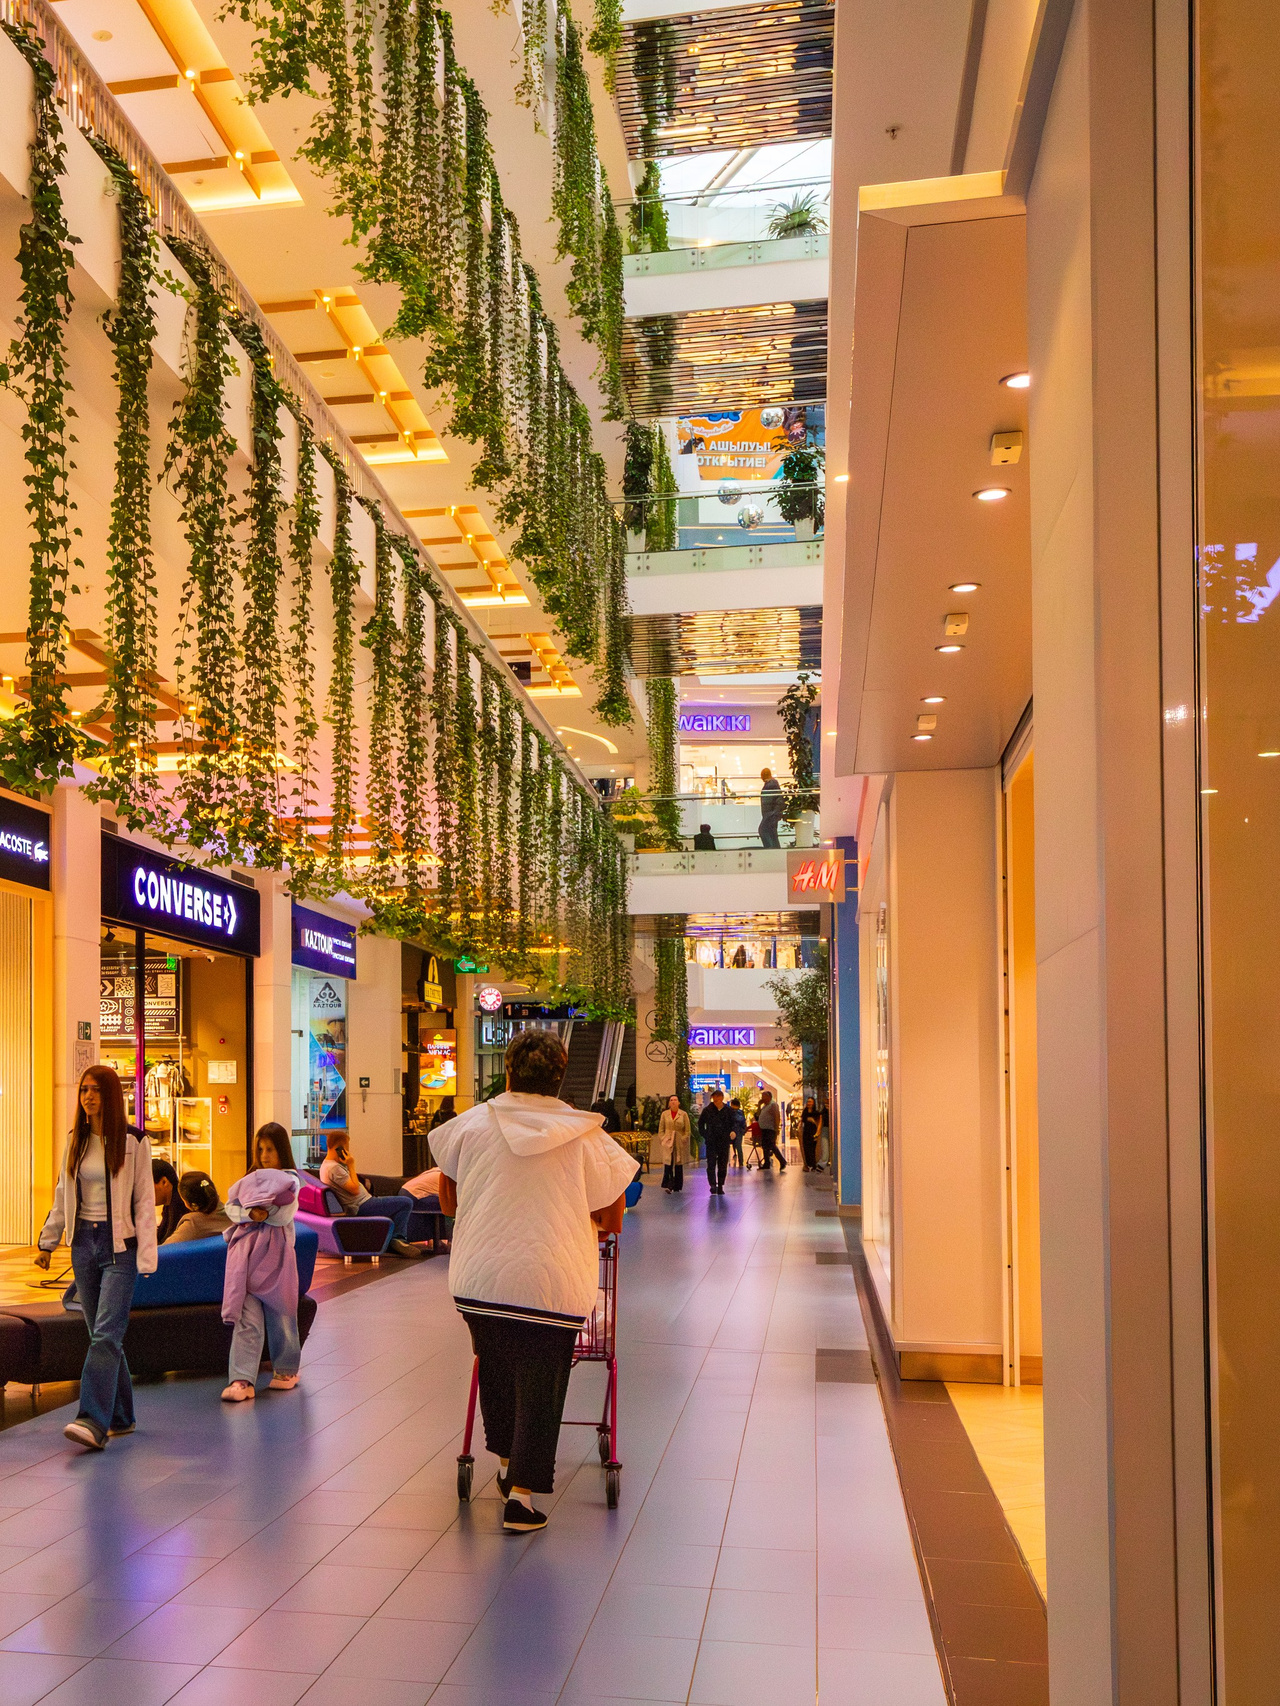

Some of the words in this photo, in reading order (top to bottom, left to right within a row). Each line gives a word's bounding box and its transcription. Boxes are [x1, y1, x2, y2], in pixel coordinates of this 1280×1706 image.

[709, 441, 771, 452] АШЫЛУЫ!
[697, 456, 766, 468] ОТКРЫТИЕ!
[792, 860, 840, 892] H&M
[134, 867, 222, 928] CONVERSE
[304, 928, 333, 955] KAZTOUR
[124, 998, 135, 1032] 1908
